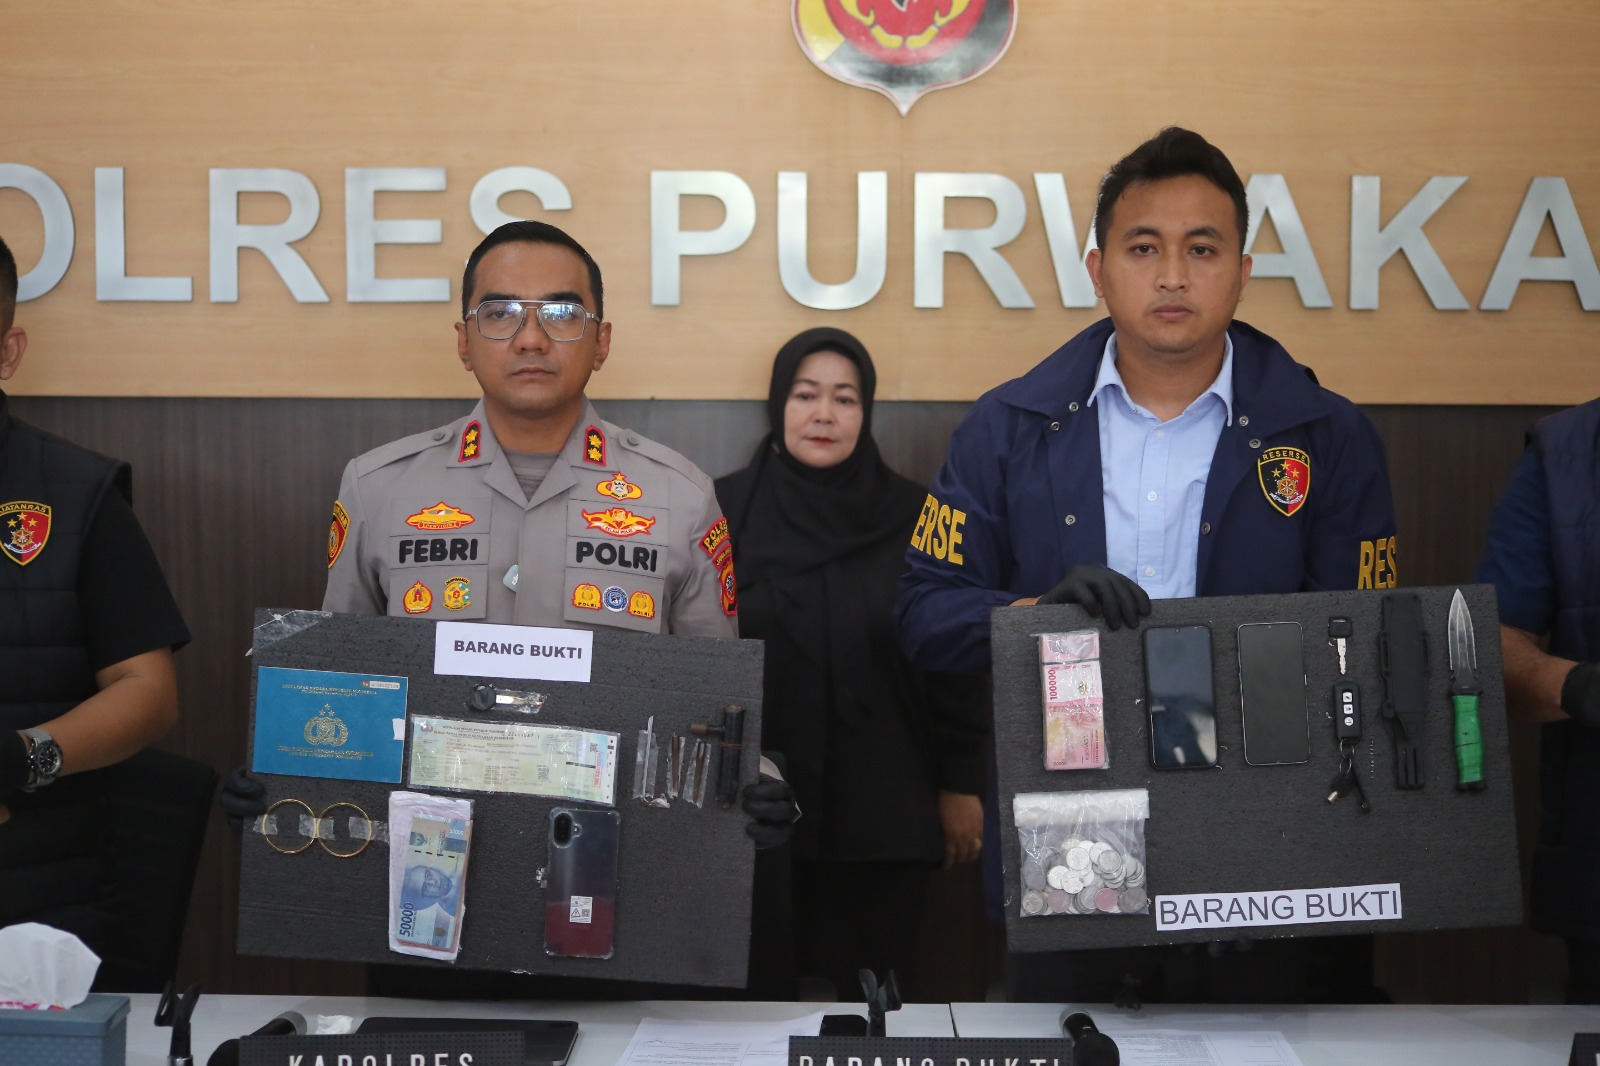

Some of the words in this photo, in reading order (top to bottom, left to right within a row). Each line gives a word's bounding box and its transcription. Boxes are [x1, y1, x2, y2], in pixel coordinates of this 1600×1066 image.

[1262, 450, 1306, 462] RESERSE
[398, 538, 478, 564] FEBRI
[576, 541, 658, 572] POLRI
[454, 640, 524, 656] BARANG
[530, 644, 582, 659] BUKTI
[1048, 669, 1058, 700] 100000
[399, 902, 414, 937] 50000
[1160, 895, 1295, 925] BARANG
[1305, 890, 1398, 919] BUKTI
